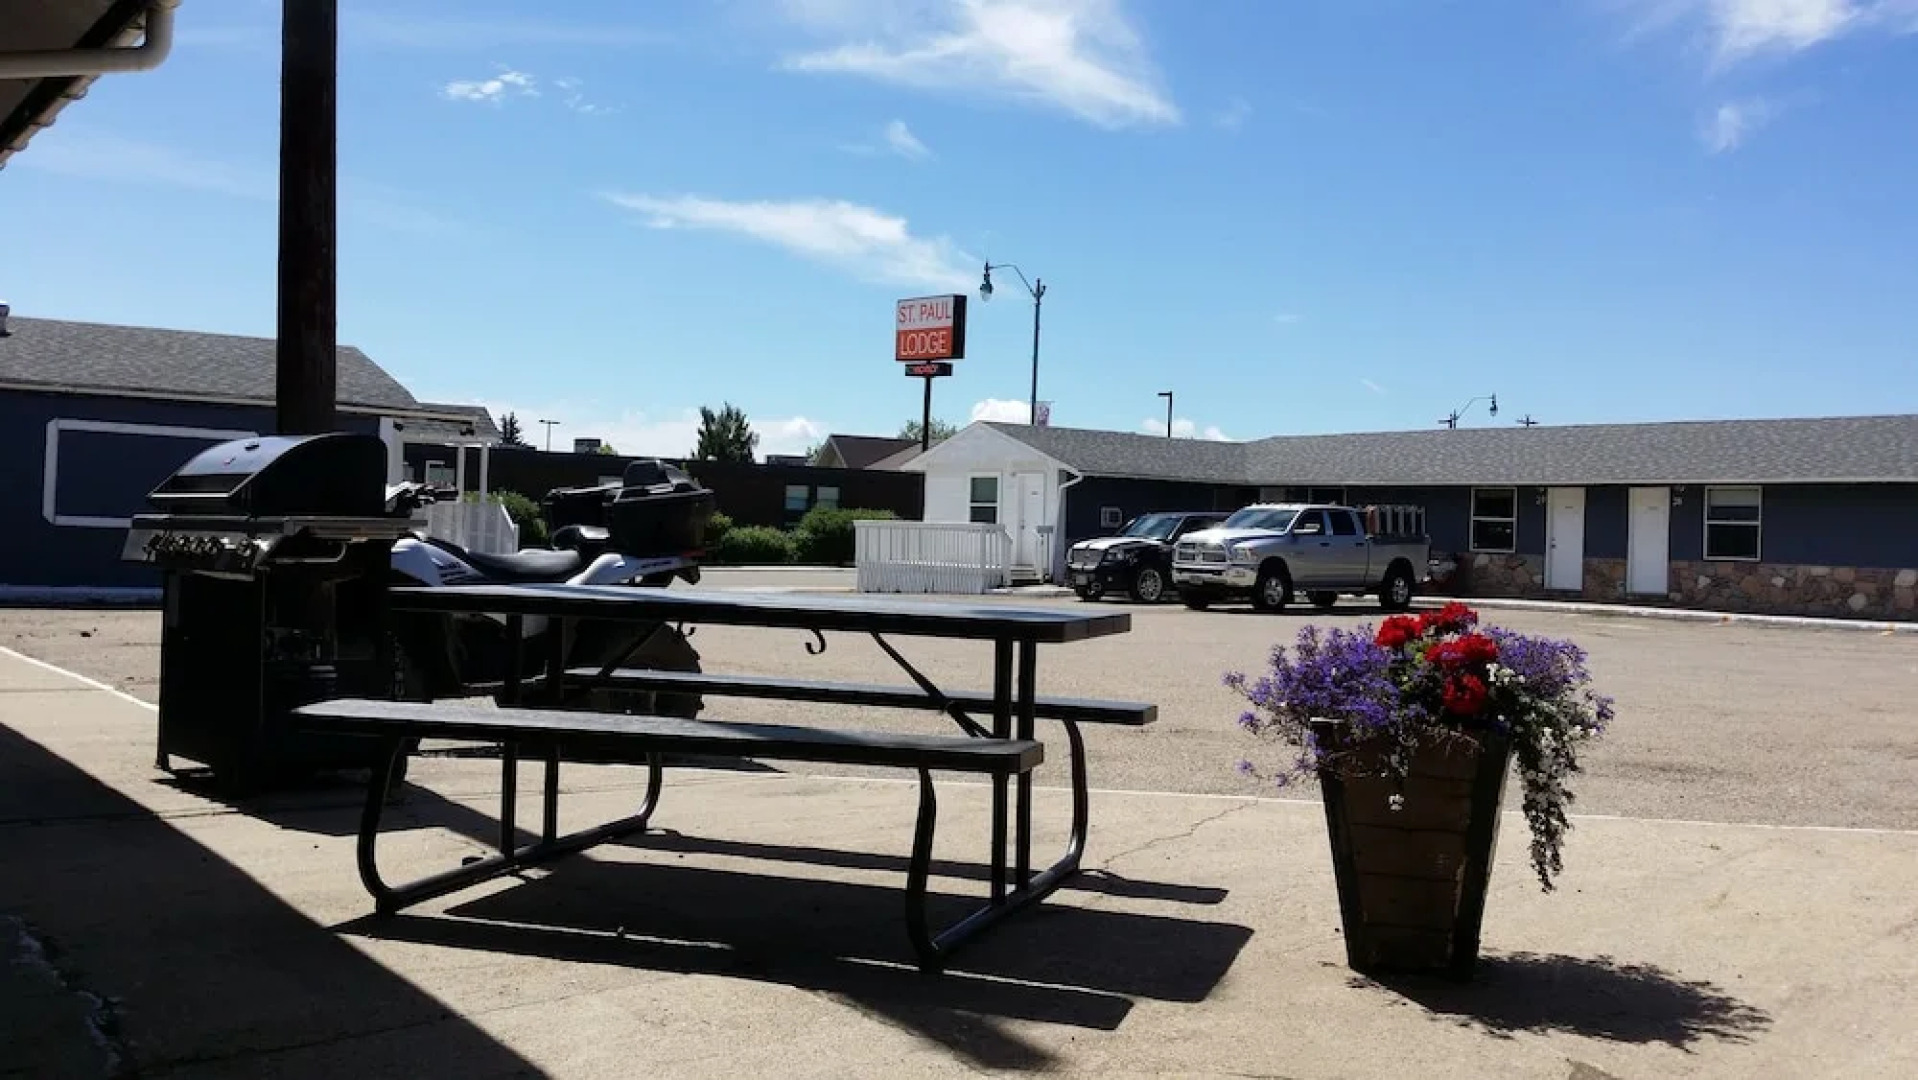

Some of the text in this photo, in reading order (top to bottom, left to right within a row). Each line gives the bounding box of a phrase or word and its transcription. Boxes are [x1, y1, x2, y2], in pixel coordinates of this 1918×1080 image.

[899, 302, 951, 322] ST. PAUL
[901, 331, 947, 355] LODGE
